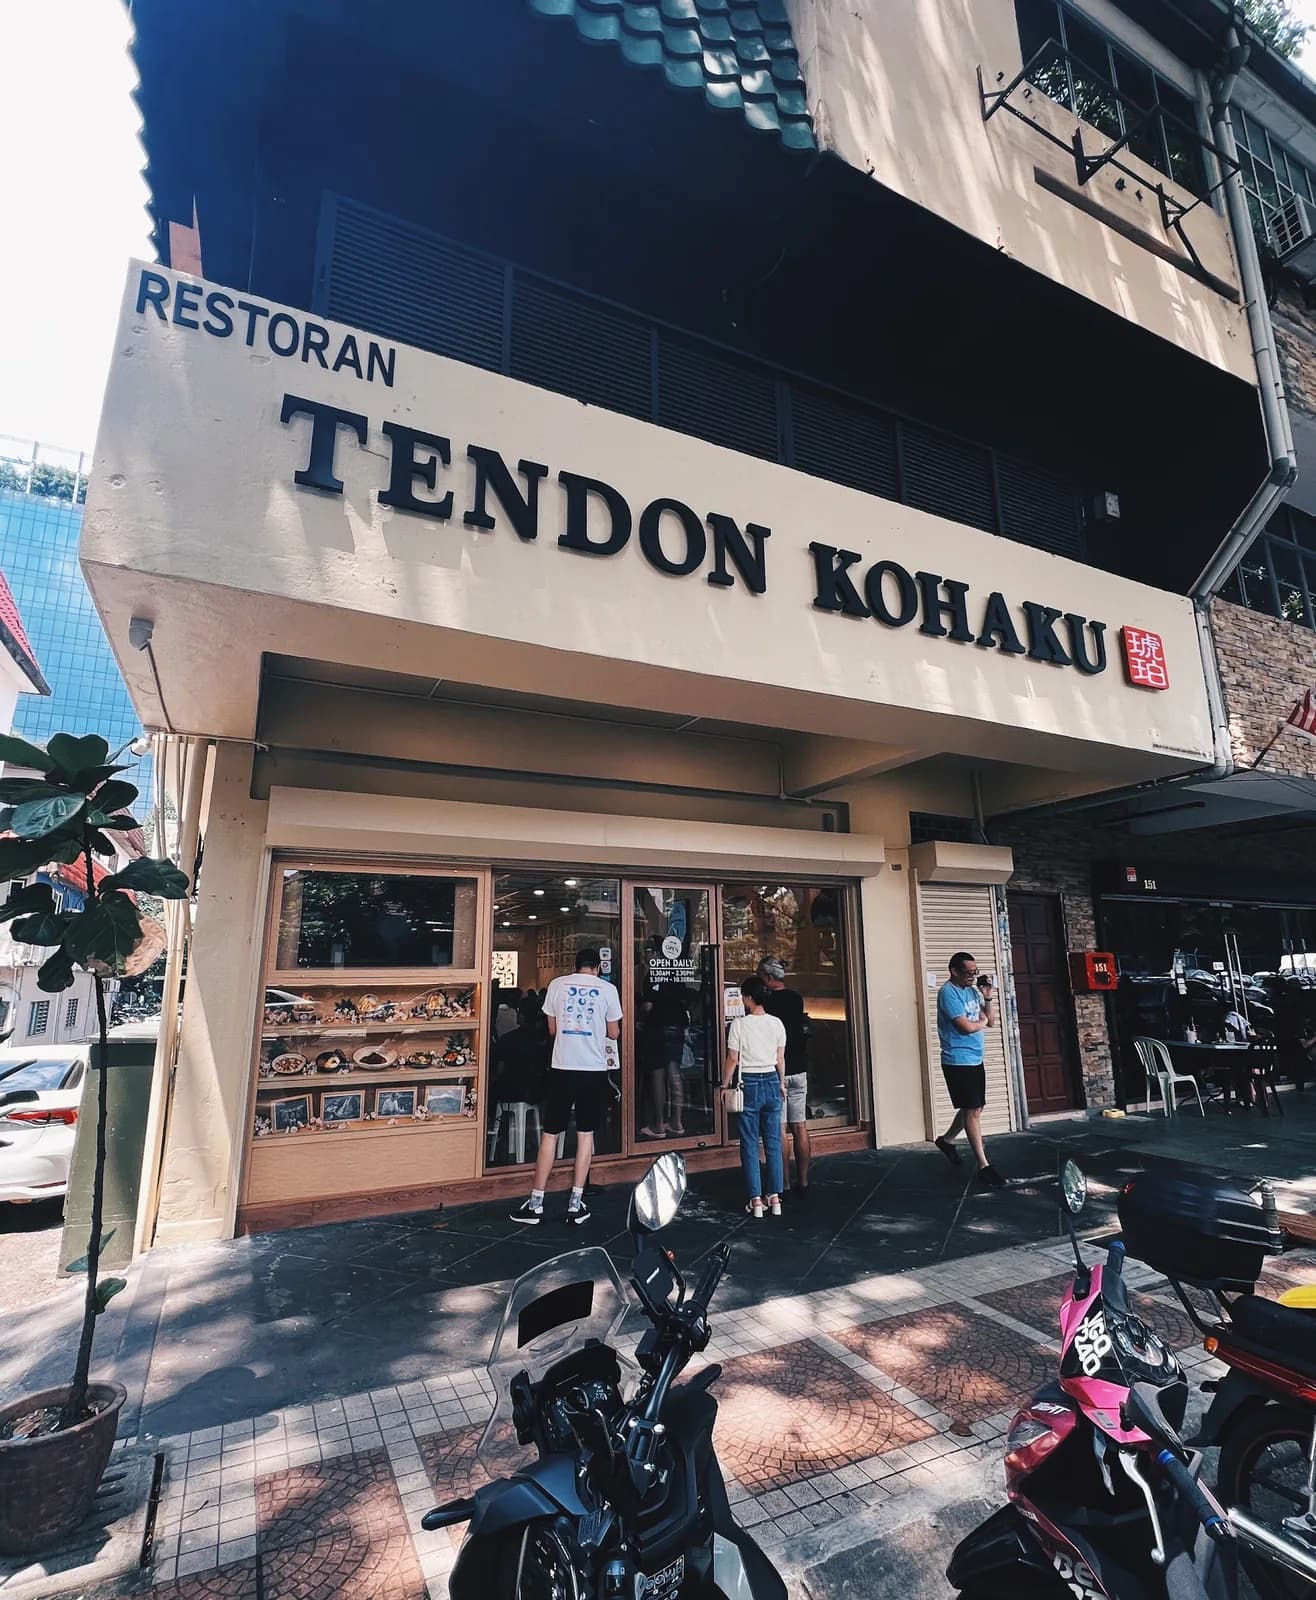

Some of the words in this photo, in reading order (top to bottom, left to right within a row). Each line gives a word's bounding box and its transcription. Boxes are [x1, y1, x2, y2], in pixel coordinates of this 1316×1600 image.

[135, 269, 396, 387] RESTORAN
[280, 394, 771, 595] TENDON
[809, 541, 1106, 674] KOHAKU
[1144, 879, 1157, 890] 151
[649, 958, 671, 967] OPEN
[672, 958, 694, 967] DAILY
[1094, 962, 1108, 973] 151
